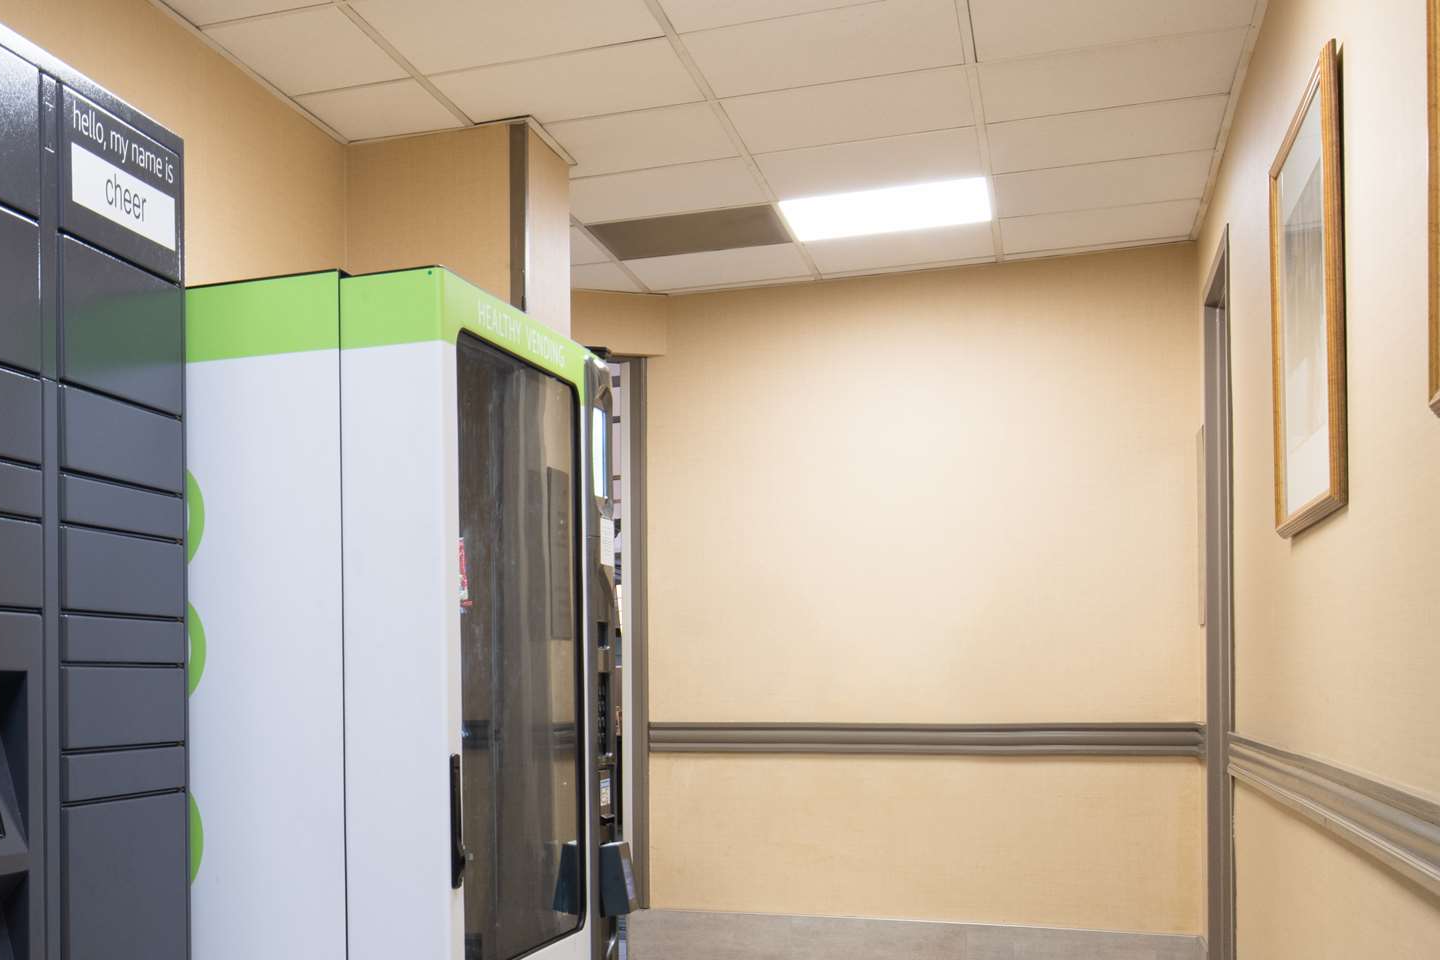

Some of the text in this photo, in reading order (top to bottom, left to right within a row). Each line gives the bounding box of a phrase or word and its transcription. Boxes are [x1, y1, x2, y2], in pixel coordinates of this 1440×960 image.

[73, 100, 174, 184] hello, my name is
[105, 173, 147, 222] cheer
[477, 302, 566, 369] HEALTHY VENDING
